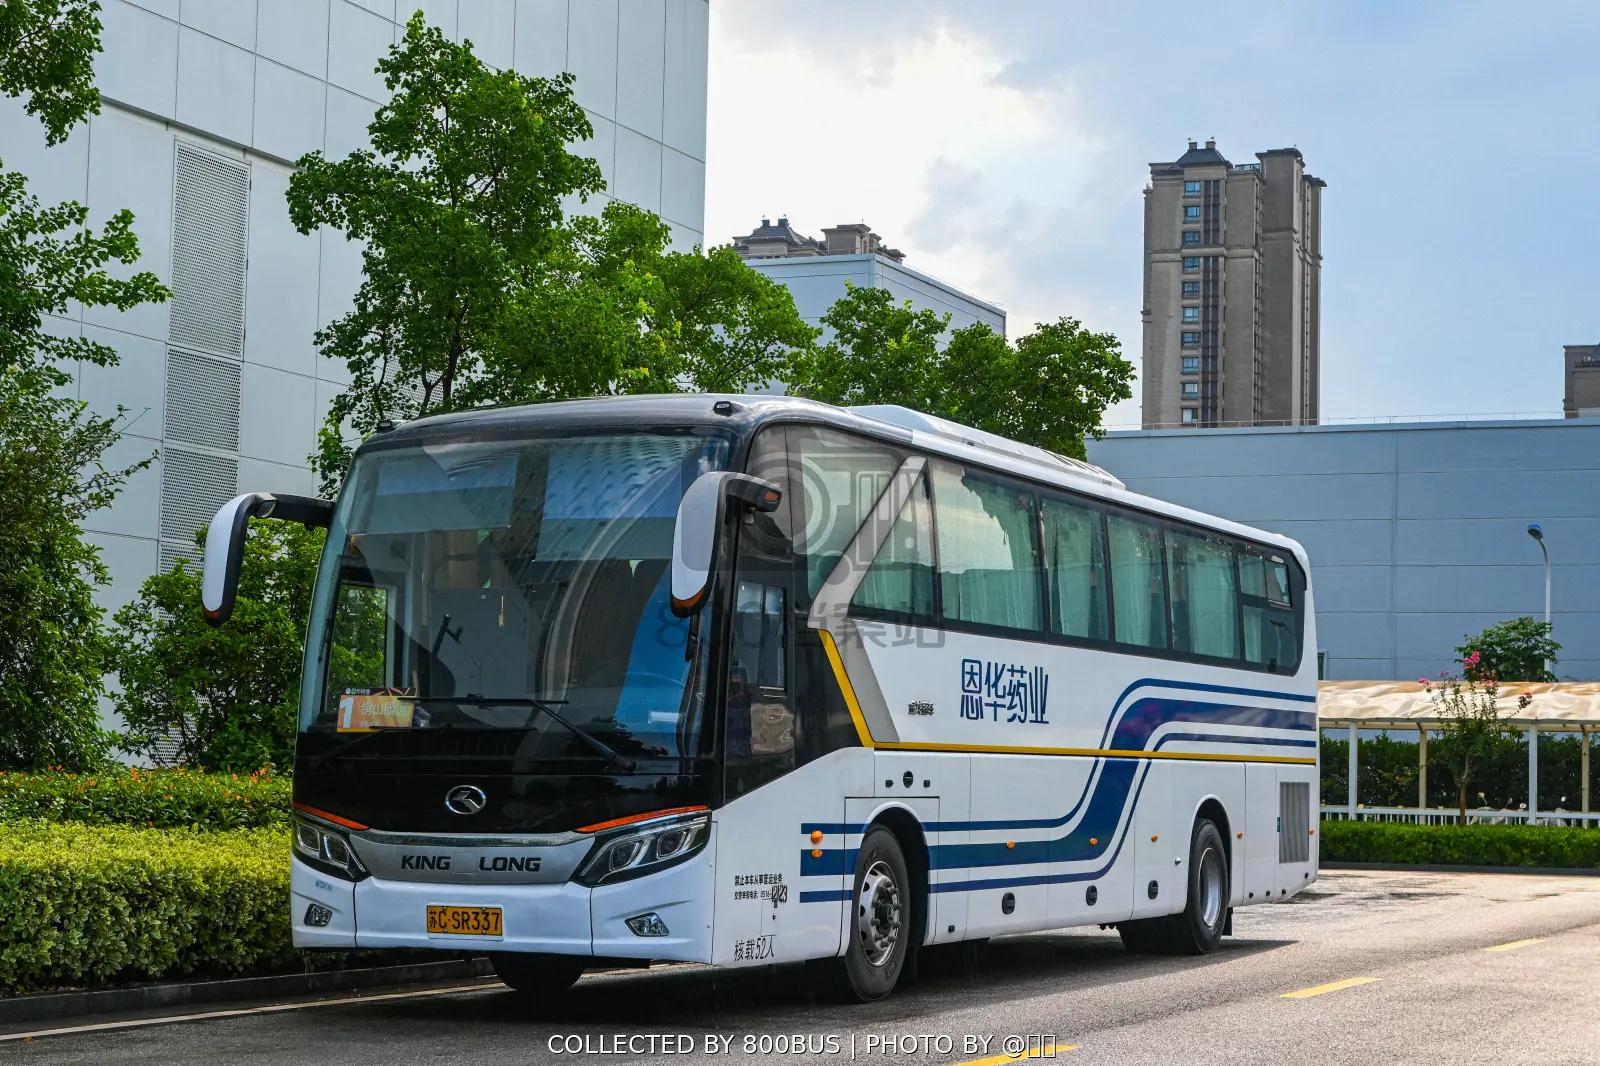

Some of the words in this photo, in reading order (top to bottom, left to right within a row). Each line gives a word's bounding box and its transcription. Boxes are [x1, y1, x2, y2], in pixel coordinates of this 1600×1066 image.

[960, 658, 1049, 724] 恩华药业
[340, 697, 354, 728] 1
[400, 855, 451, 870] KING
[479, 856, 542, 872] LONG
[734, 873, 783, 886] 禁止本车从事营运业务
[734, 936, 774, 961] 核载52人
